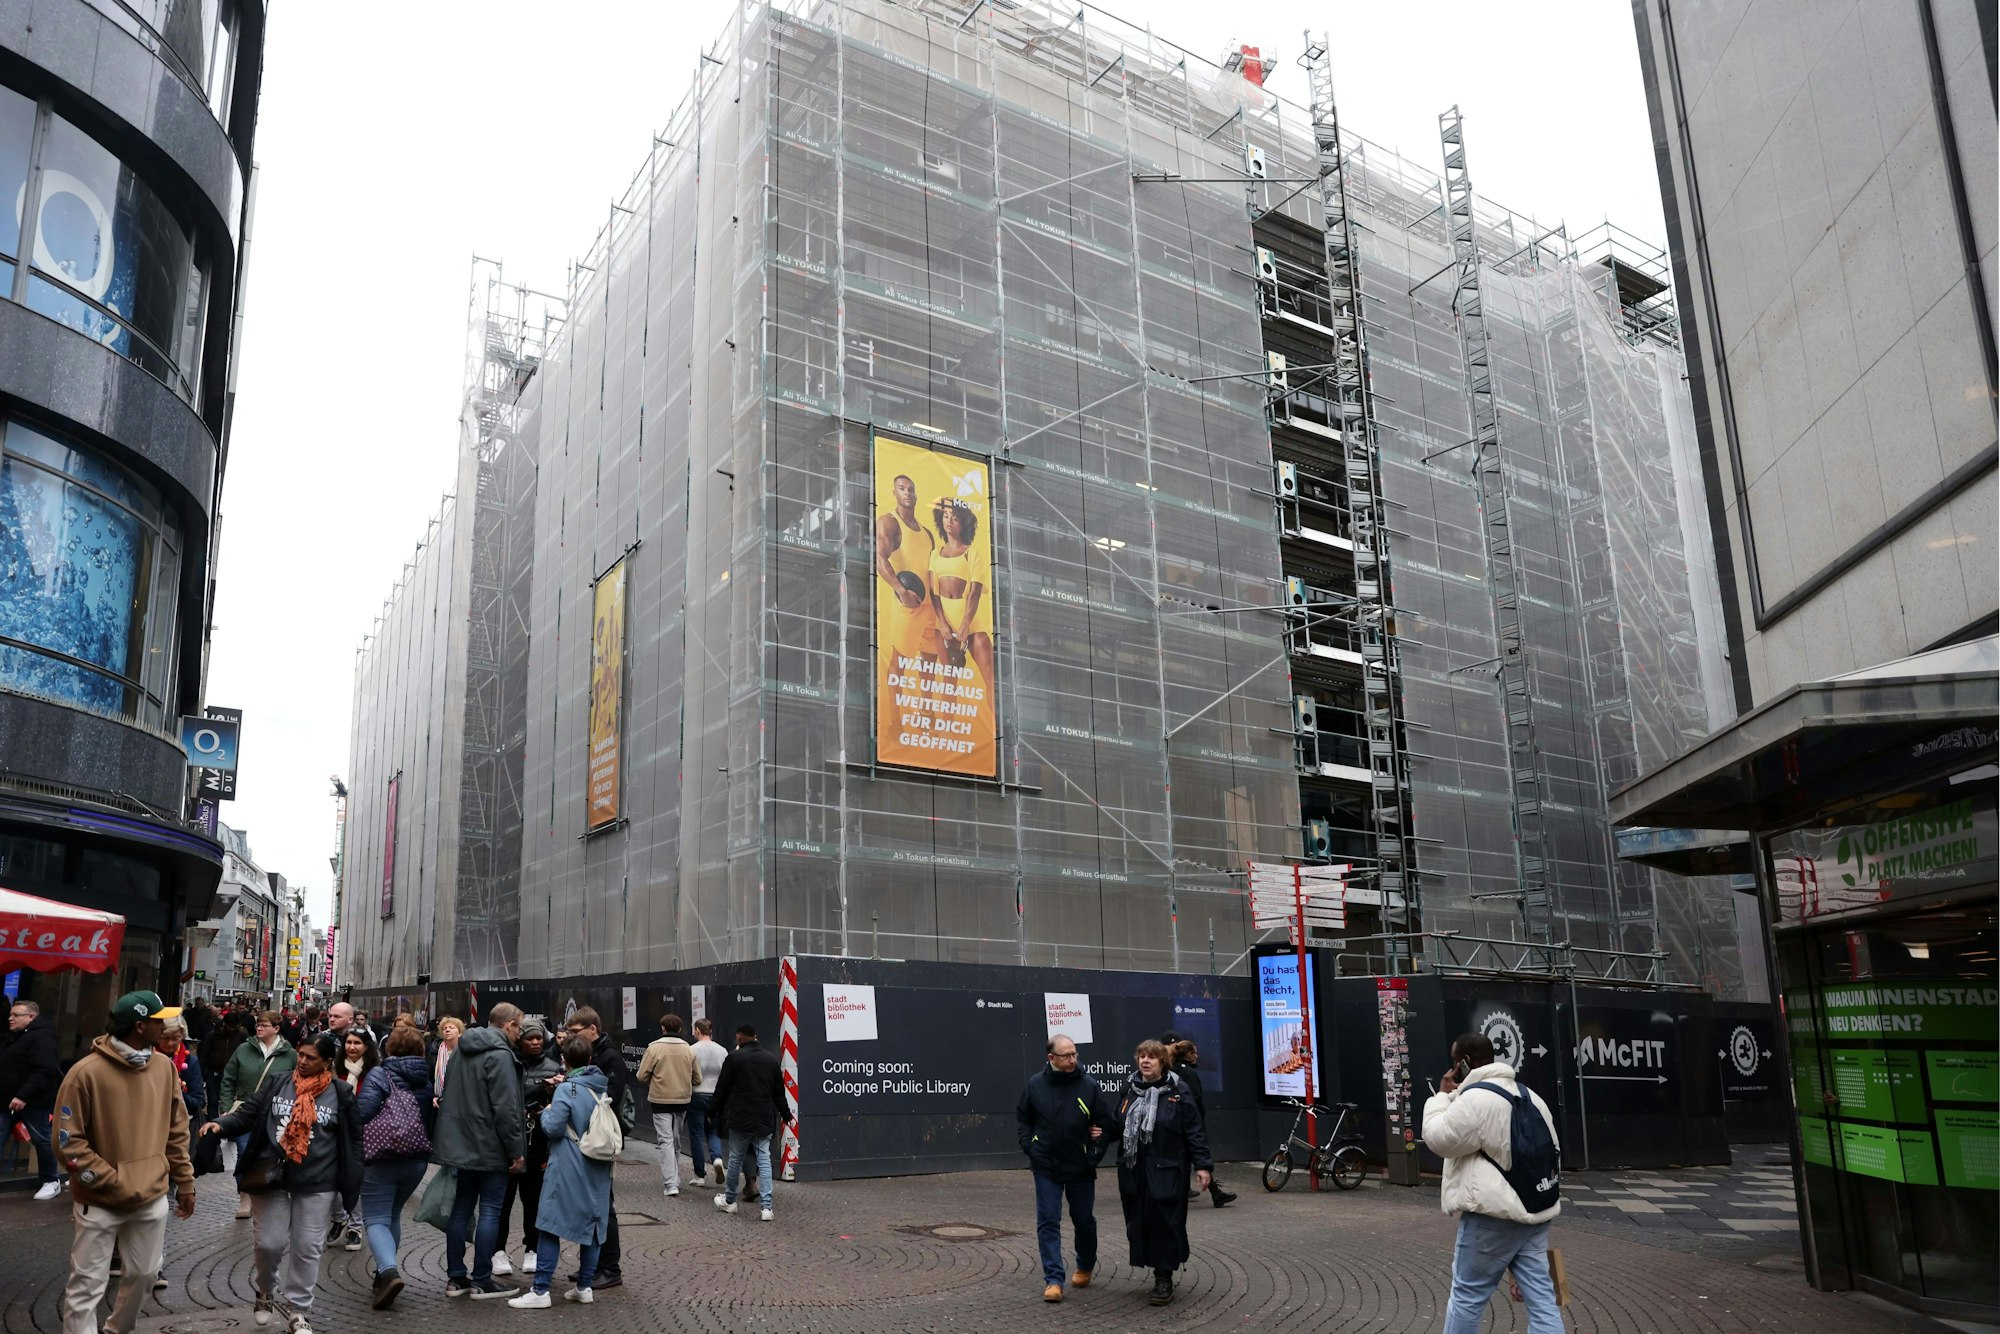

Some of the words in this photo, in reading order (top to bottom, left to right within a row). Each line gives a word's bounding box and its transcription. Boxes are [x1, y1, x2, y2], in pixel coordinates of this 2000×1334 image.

[798, 134, 820, 148] Tokus
[1026, 218, 1038, 226] ALI
[1040, 222, 1066, 238] TOKUS
[776, 254, 792, 264] ALI
[793, 258, 826, 274] TOKUS
[896, 293, 918, 305] Tokus
[783, 390, 794, 398] Ali
[796, 393, 818, 406] Tokus
[888, 420, 898, 428] Ali
[898, 424, 920, 436] Tokus
[1056, 466, 1075, 476] Tokus
[953, 498, 982, 512] McFIT
[783, 535, 794, 544] Ali
[796, 538, 820, 550] Tokus
[1040, 588, 1054, 597] ALI
[1056, 592, 1084, 604] TOKUS
[896, 654, 974, 681] WÄHREND
[796, 686, 820, 697] Tokus
[887, 674, 916, 688] DES
[920, 679, 984, 700] UMBAUS
[895, 693, 978, 718] WEITERHIN
[902, 712, 930, 730] FÜR
[934, 720, 972, 735] DICH
[1046, 724, 1059, 733] ALI
[1061, 727, 1090, 738] TOKUS
[900, 732, 976, 753] GEÖFFNET
[1209, 750, 1228, 759] Tokus
[1228, 753, 1258, 764] Gerüstbau
[1864, 799, 1974, 856] OFFENSIVE
[782, 840, 794, 848] Ali
[796, 842, 820, 852] Tokus
[1868, 858, 1905, 882] PLATZ
[1908, 838, 1978, 872] MACHEN!
[1062, 868, 1072, 876] Ali
[1072, 870, 1092, 878] Tokus
[1094, 872, 1128, 882] Gerüstbau
[0, 928, 110, 954] steak
[1262, 966, 1274, 975] Du
[1278, 965, 1299, 974] hast
[1264, 977, 1280, 985] das
[1264, 986, 1295, 995] Recht,
[827, 995, 847, 1004] stadt
[1825, 990, 1864, 1008] WARUM
[827, 1003, 866, 1012] bibliothek
[1048, 1010, 1082, 1018] bibliothek
[828, 1012, 845, 1020] köln
[1828, 1016, 1849, 1031] NEU
[1850, 1014, 1924, 1032] DENKEN?
[622, 1043, 636, 1056] Coming
[1597, 1038, 1665, 1068] McFIT
[822, 1059, 874, 1077] Coming
[878, 1060, 914, 1074] soon:
[1083, 1061, 1104, 1074] uch
[1107, 1061, 1131, 1074] hier:
[822, 1079, 878, 1096] Cologne
[881, 1079, 923, 1095] Public
[927, 1079, 970, 1097] Library
[272, 1096, 296, 1106] HEAL
